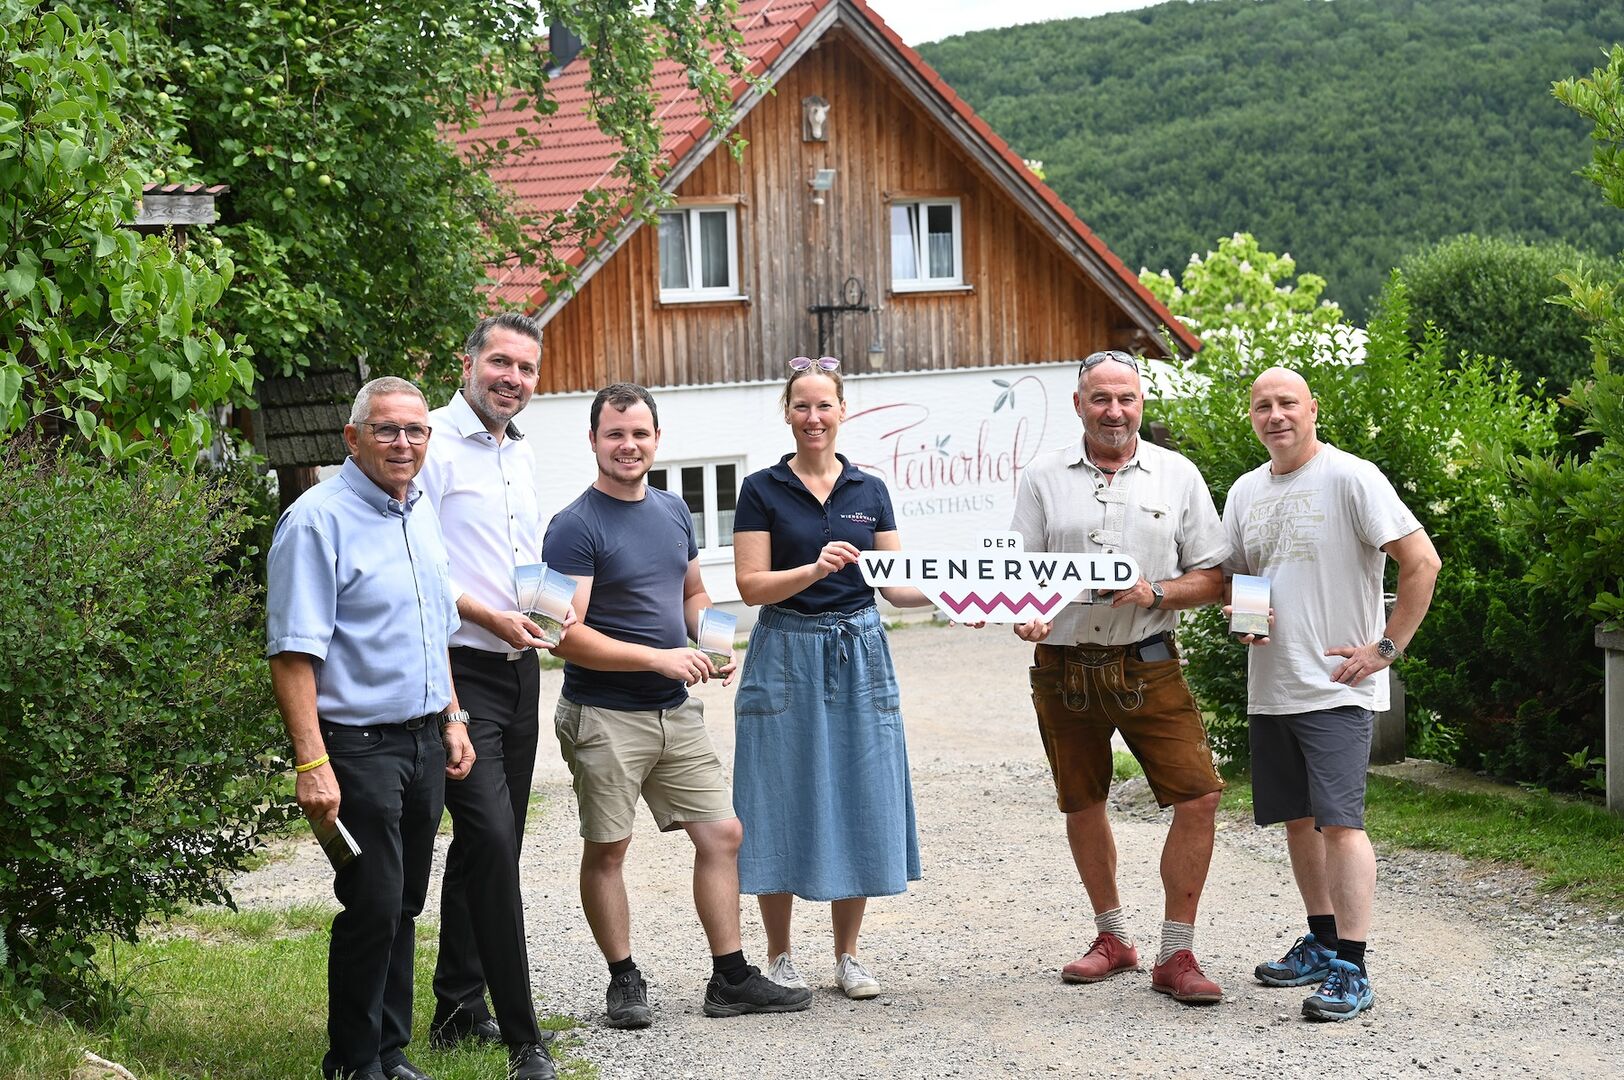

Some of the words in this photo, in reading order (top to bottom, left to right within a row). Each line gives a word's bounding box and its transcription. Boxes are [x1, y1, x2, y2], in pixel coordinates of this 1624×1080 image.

[902, 495, 994, 518] GASTHAUS
[984, 538, 1016, 548] DER
[865, 558, 1132, 582] WIENERWALD
